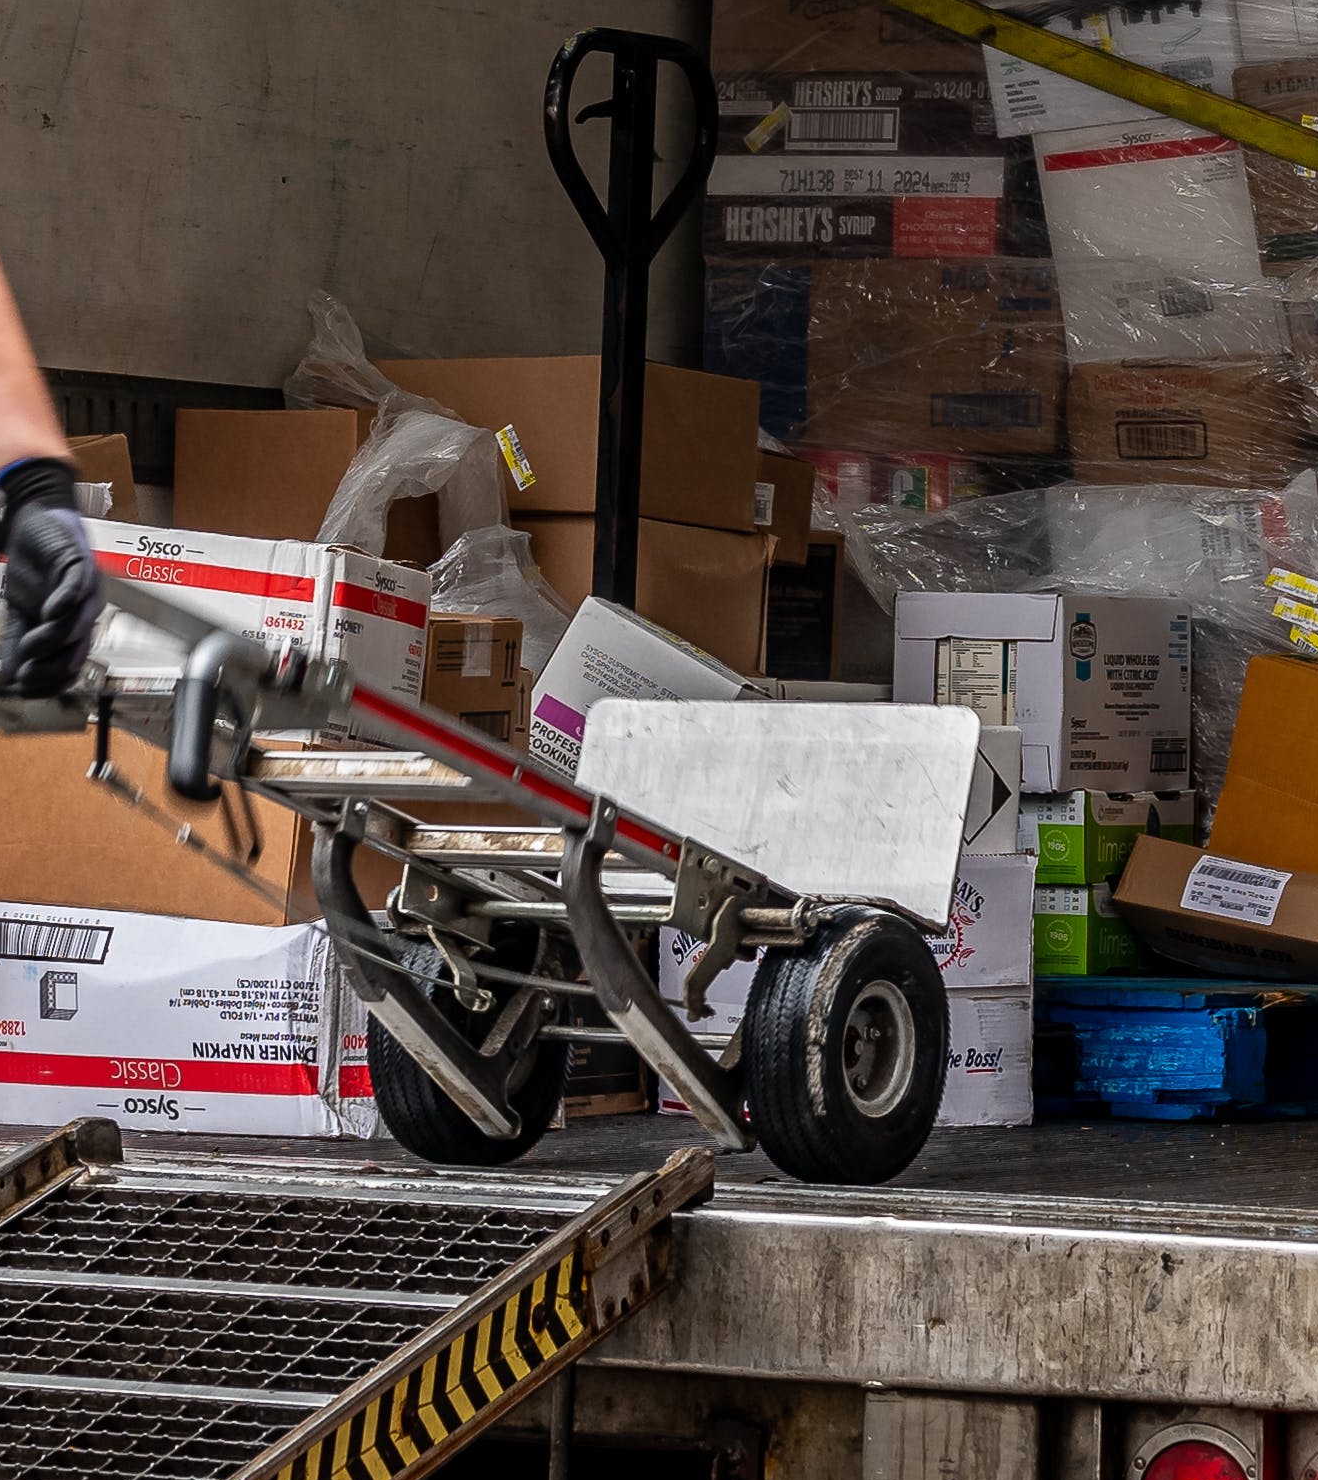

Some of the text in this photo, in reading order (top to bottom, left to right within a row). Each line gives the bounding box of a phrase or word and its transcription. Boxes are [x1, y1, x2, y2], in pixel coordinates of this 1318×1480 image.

[718, 81, 735, 100] 24
[794, 80, 902, 106] HERSHEY'S SYRUP
[1122, 133, 1152, 146] Sysco
[894, 170, 931, 193] 2024
[723, 206, 877, 242] HERSHEY'S SYRUP
[136, 536, 182, 557] Sysco
[126, 558, 184, 584] Classic
[375, 571, 396, 592] Sysco
[584, 643, 609, 662] SYSCO
[607, 657, 641, 680] SUPREME
[1104, 654, 1160, 666] LIQUID WHOLE EGG
[599, 662, 619, 677] SPRAY
[1106, 669, 1123, 681] WITH
[1124, 669, 1142, 681] CITRIC
[582, 671, 608, 690] BEST BY
[532, 721, 582, 758] PROFESS
[236, 978, 291, 989] CT (1200/CS)
[180, 986, 195, 996] cm)
[196, 987, 219, 997] 43.18
[227, 989, 239, 997] cm
[241, 988, 268, 999] (43.18
[269, 990, 279, 999] IN
[281, 990, 292, 1000] 17
[169, 998, 182, 1007] 1/4
[183, 998, 210, 1008] Doblez
[215, 999, 245, 1009] Dobles
[246, 998, 266, 1009] Hojas
[220, 1010, 287, 1021] 2 PLY 1/4 FOLD
[240, 1031, 280, 1042] para Mesa
[192, 1042, 255, 1060] NAPKIN
[946, 1047, 1004, 1068] he Boss!
[109, 1059, 181, 1088] Classic
[124, 1094, 179, 1121] Sysco
